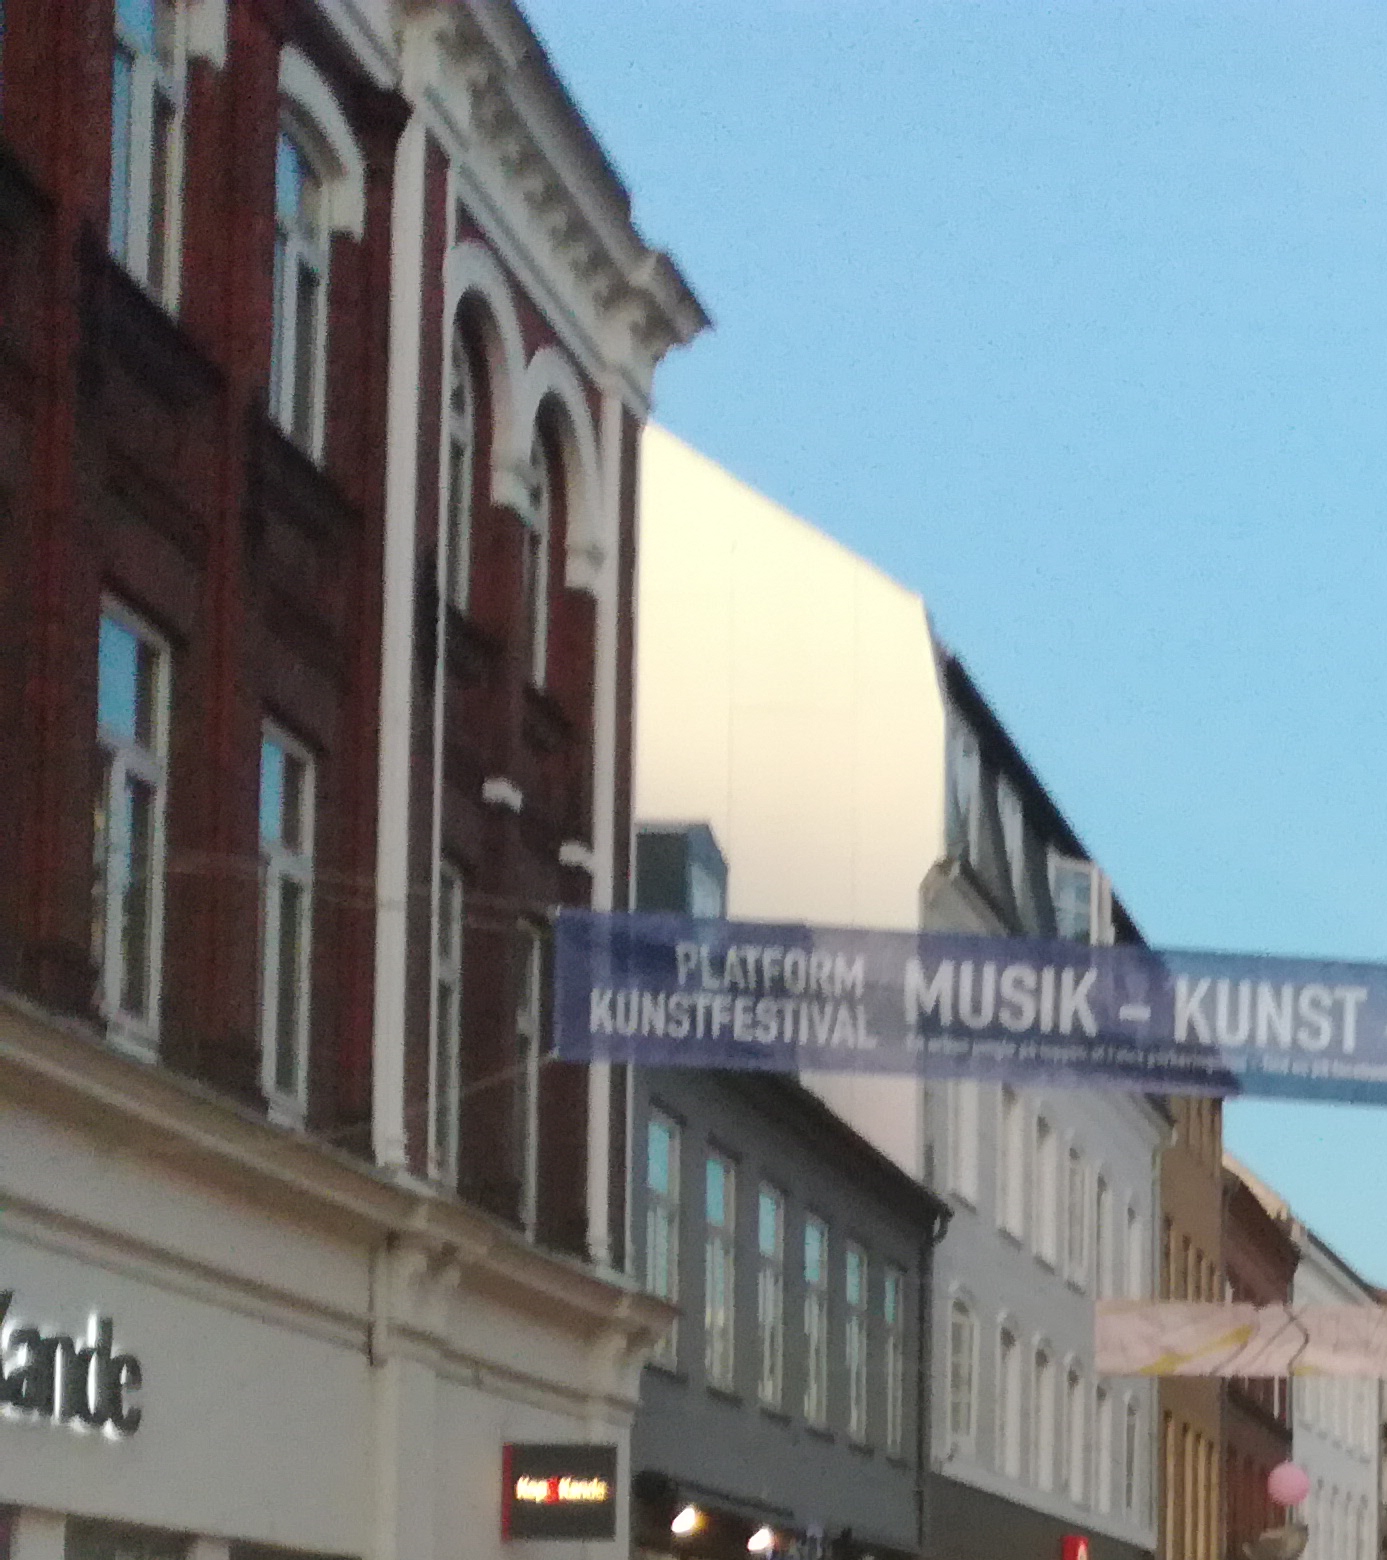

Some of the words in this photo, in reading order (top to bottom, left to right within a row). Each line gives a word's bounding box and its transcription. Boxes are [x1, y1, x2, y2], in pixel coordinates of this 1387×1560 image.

[676, 942, 865, 998] PLATFORM
[903, 959, 1097, 1037] MUSIK
[1174, 975, 1367, 1054] KUNST
[590, 987, 877, 1048] KUNSTFESTIVAL
[0, 1289, 143, 1436] ande
